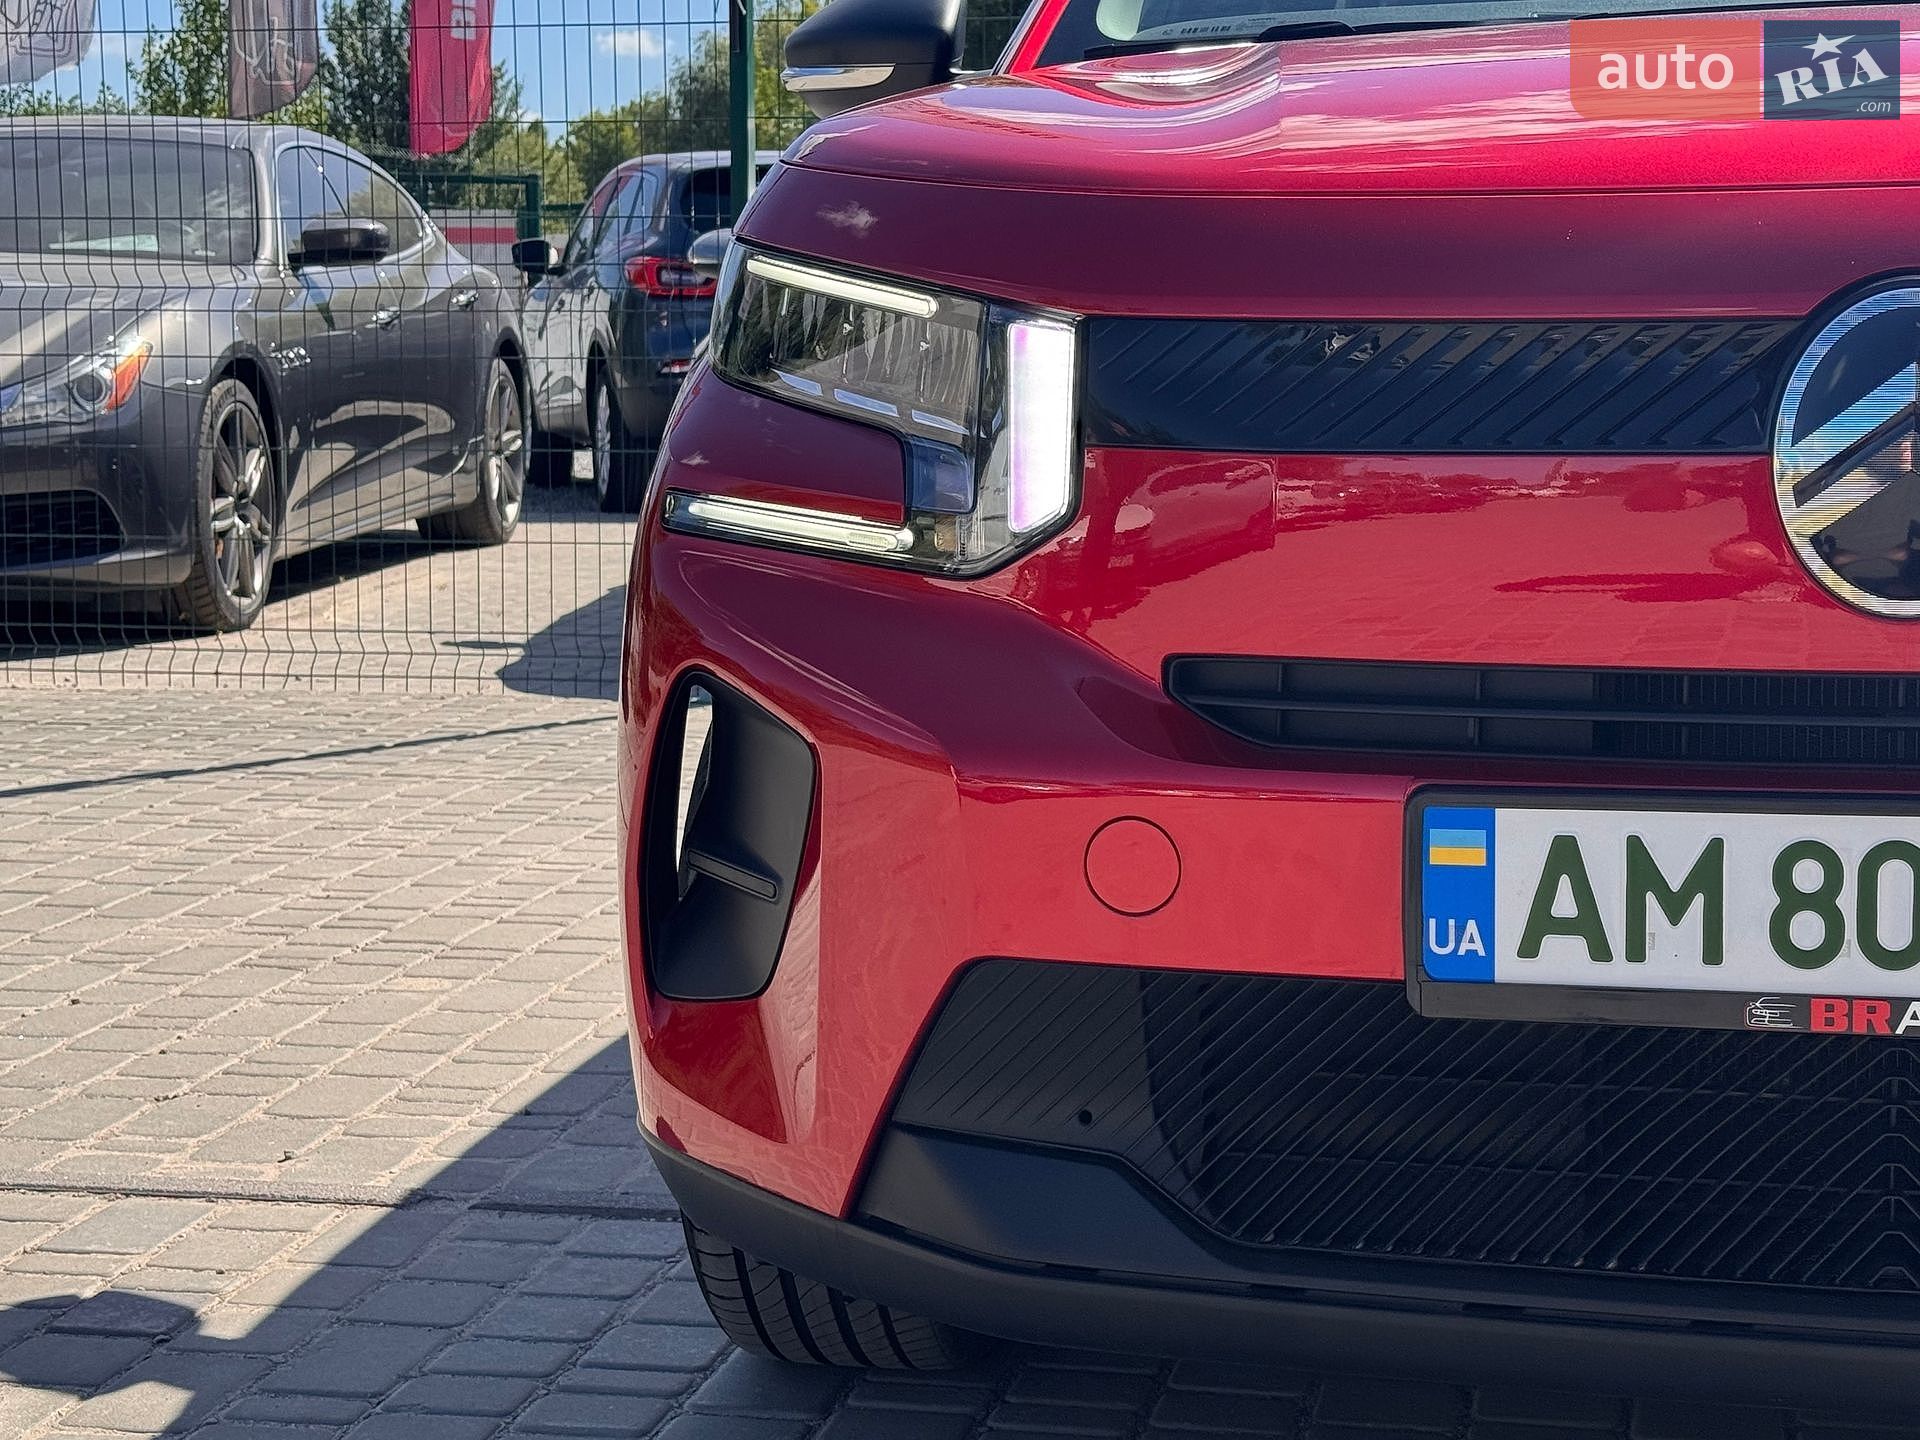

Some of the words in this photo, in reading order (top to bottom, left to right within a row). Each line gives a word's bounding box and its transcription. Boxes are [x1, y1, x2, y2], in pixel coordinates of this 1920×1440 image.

[1429, 918, 1486, 957] UA
[1516, 834, 1725, 966] AM
[1769, 839, 1920, 971] 80
